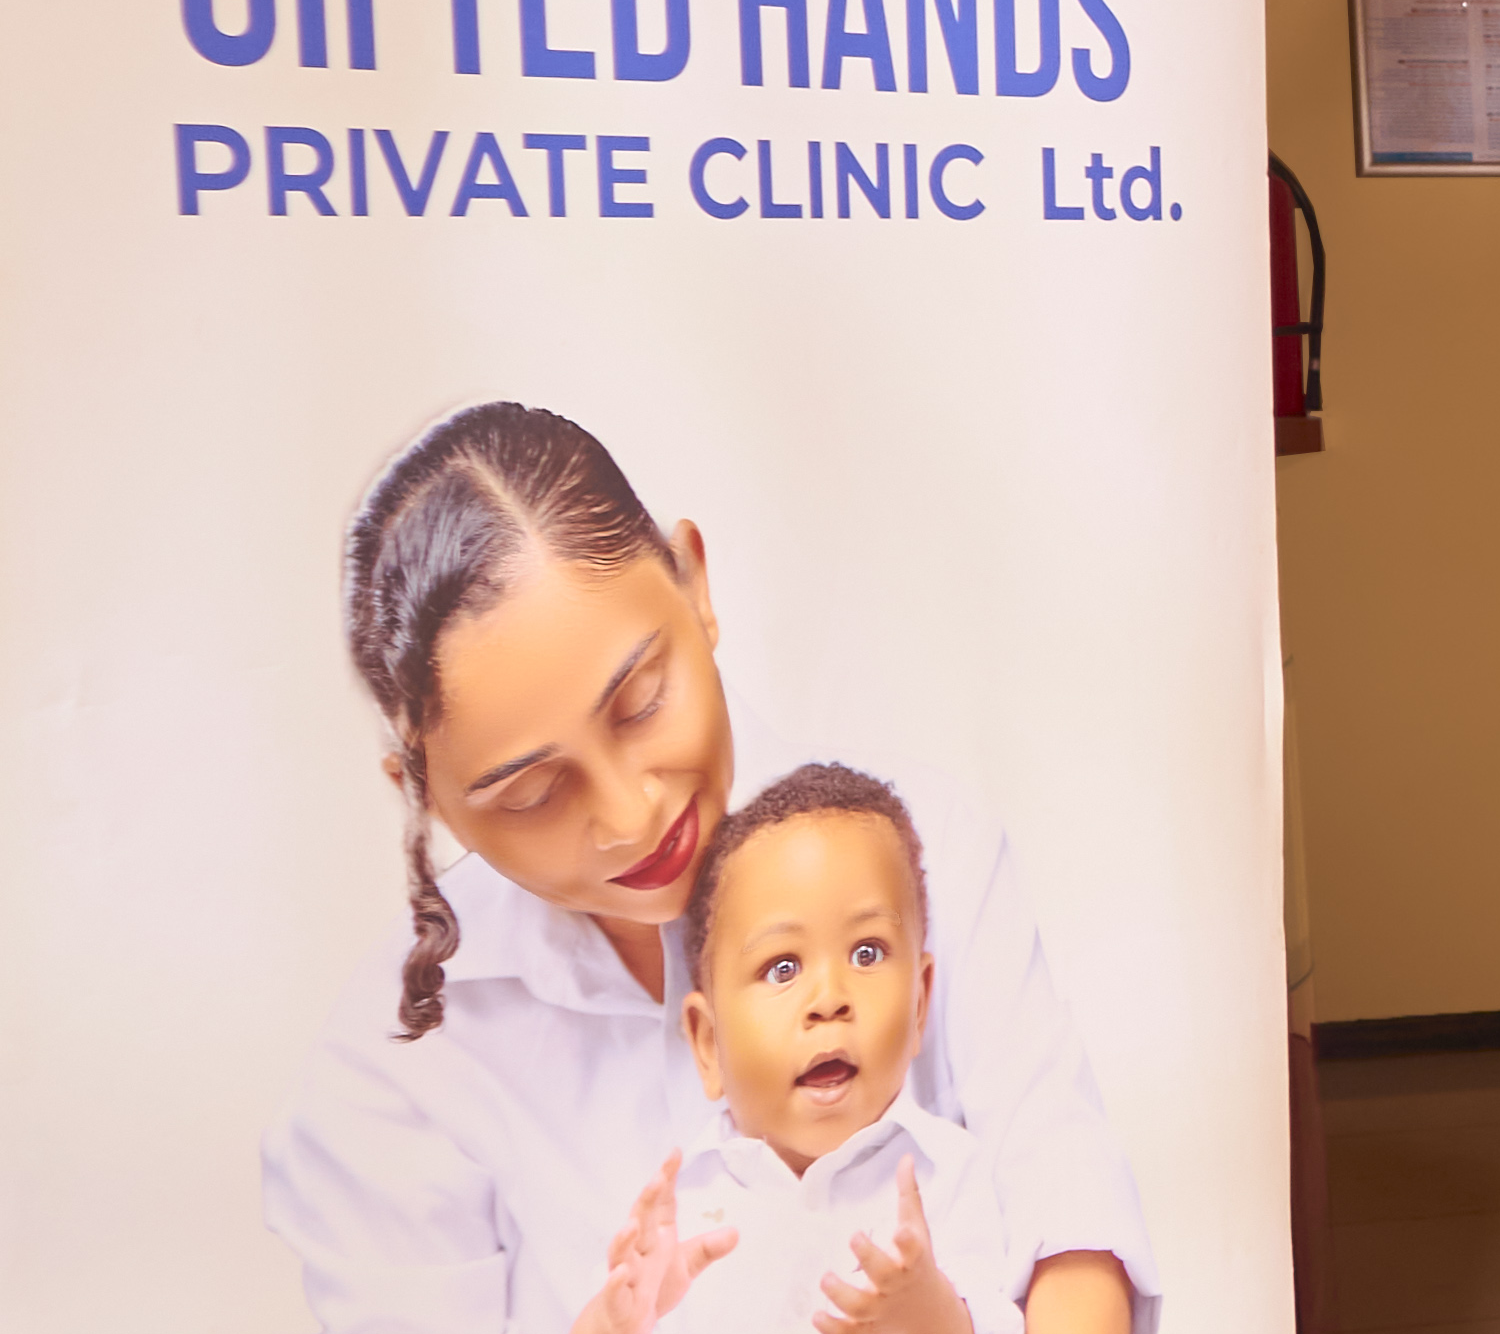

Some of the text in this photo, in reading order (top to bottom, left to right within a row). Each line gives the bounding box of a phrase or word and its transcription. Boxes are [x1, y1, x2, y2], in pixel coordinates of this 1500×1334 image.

[173, 123, 1183, 222] PRIVATE CLINIC Ltd.
